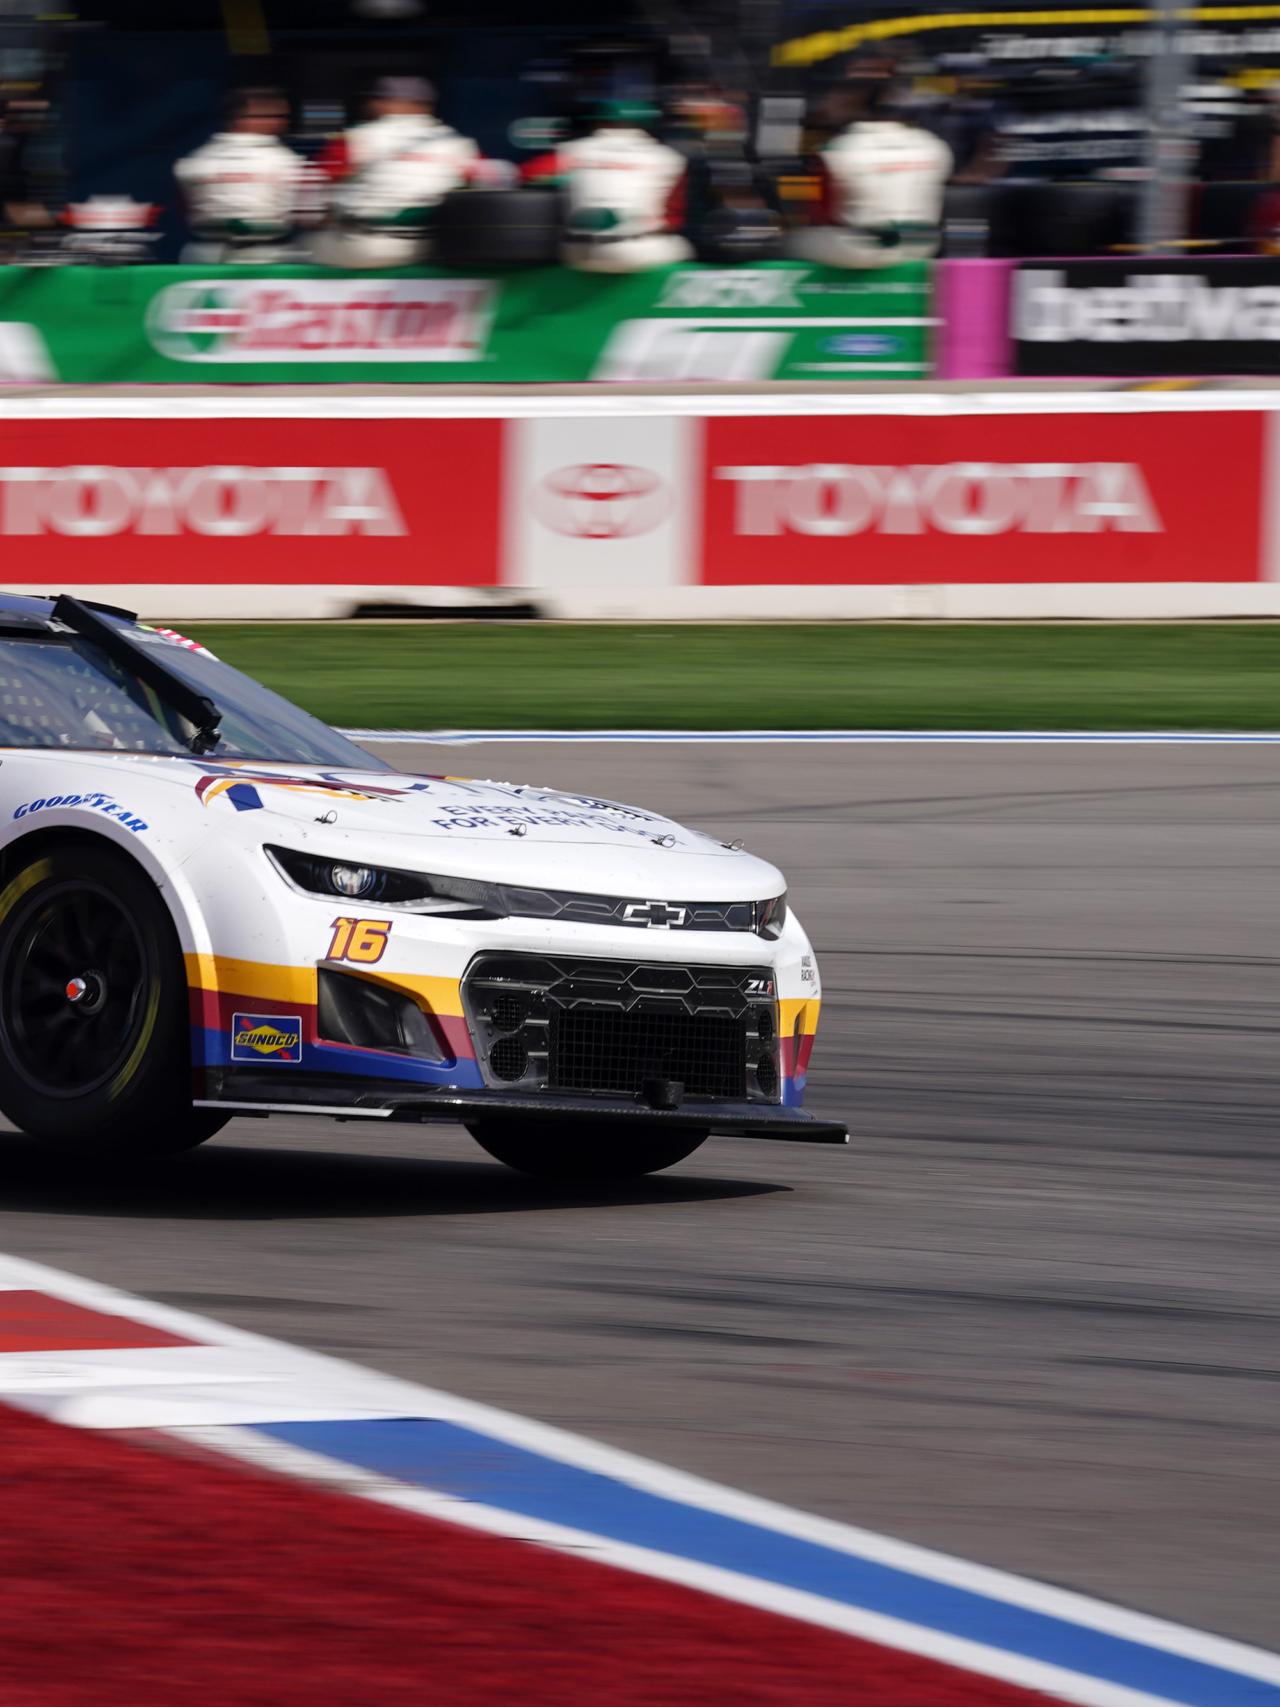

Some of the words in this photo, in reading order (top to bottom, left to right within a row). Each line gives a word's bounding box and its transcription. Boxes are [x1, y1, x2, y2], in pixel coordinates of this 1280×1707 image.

[714, 462, 1163, 536] TOYOTA
[431, 816, 500, 830] FOR
[325, 916, 393, 964] 16
[235, 1031, 298, 1048] SUNOCO
